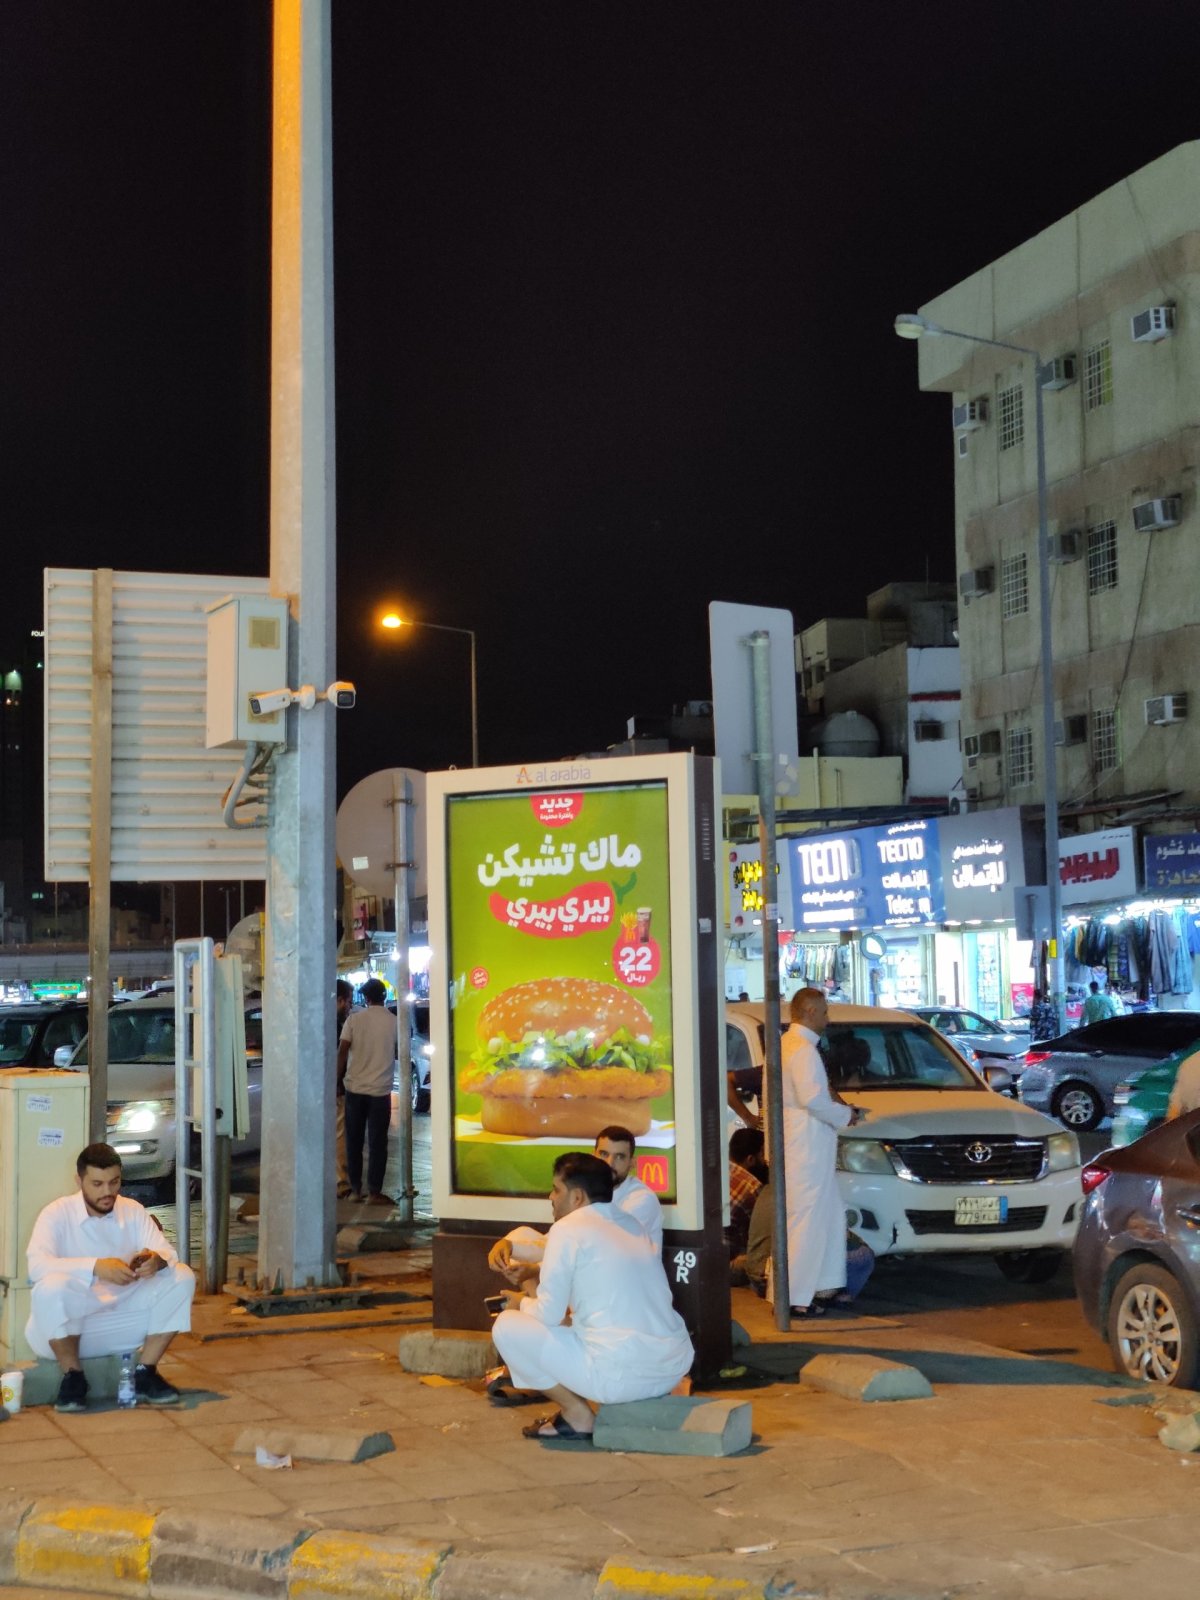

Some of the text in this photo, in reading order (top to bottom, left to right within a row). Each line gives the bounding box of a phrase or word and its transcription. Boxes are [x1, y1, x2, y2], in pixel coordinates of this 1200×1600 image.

[550, 765, 592, 783] arabia
[539, 797, 574, 813] جديد
[877, 836, 924, 864] TECNO
[477, 834, 642, 887] ماك تشيكن
[798, 838, 862, 885] TECNO
[506, 896, 610, 932] بيري بيري
[885, 895, 931, 915] Telecm
[619, 946, 652, 972] 22
[627, 973, 646, 983] ريال
[673, 1250, 697, 1269] 49
[676, 1266, 689, 1284] R
